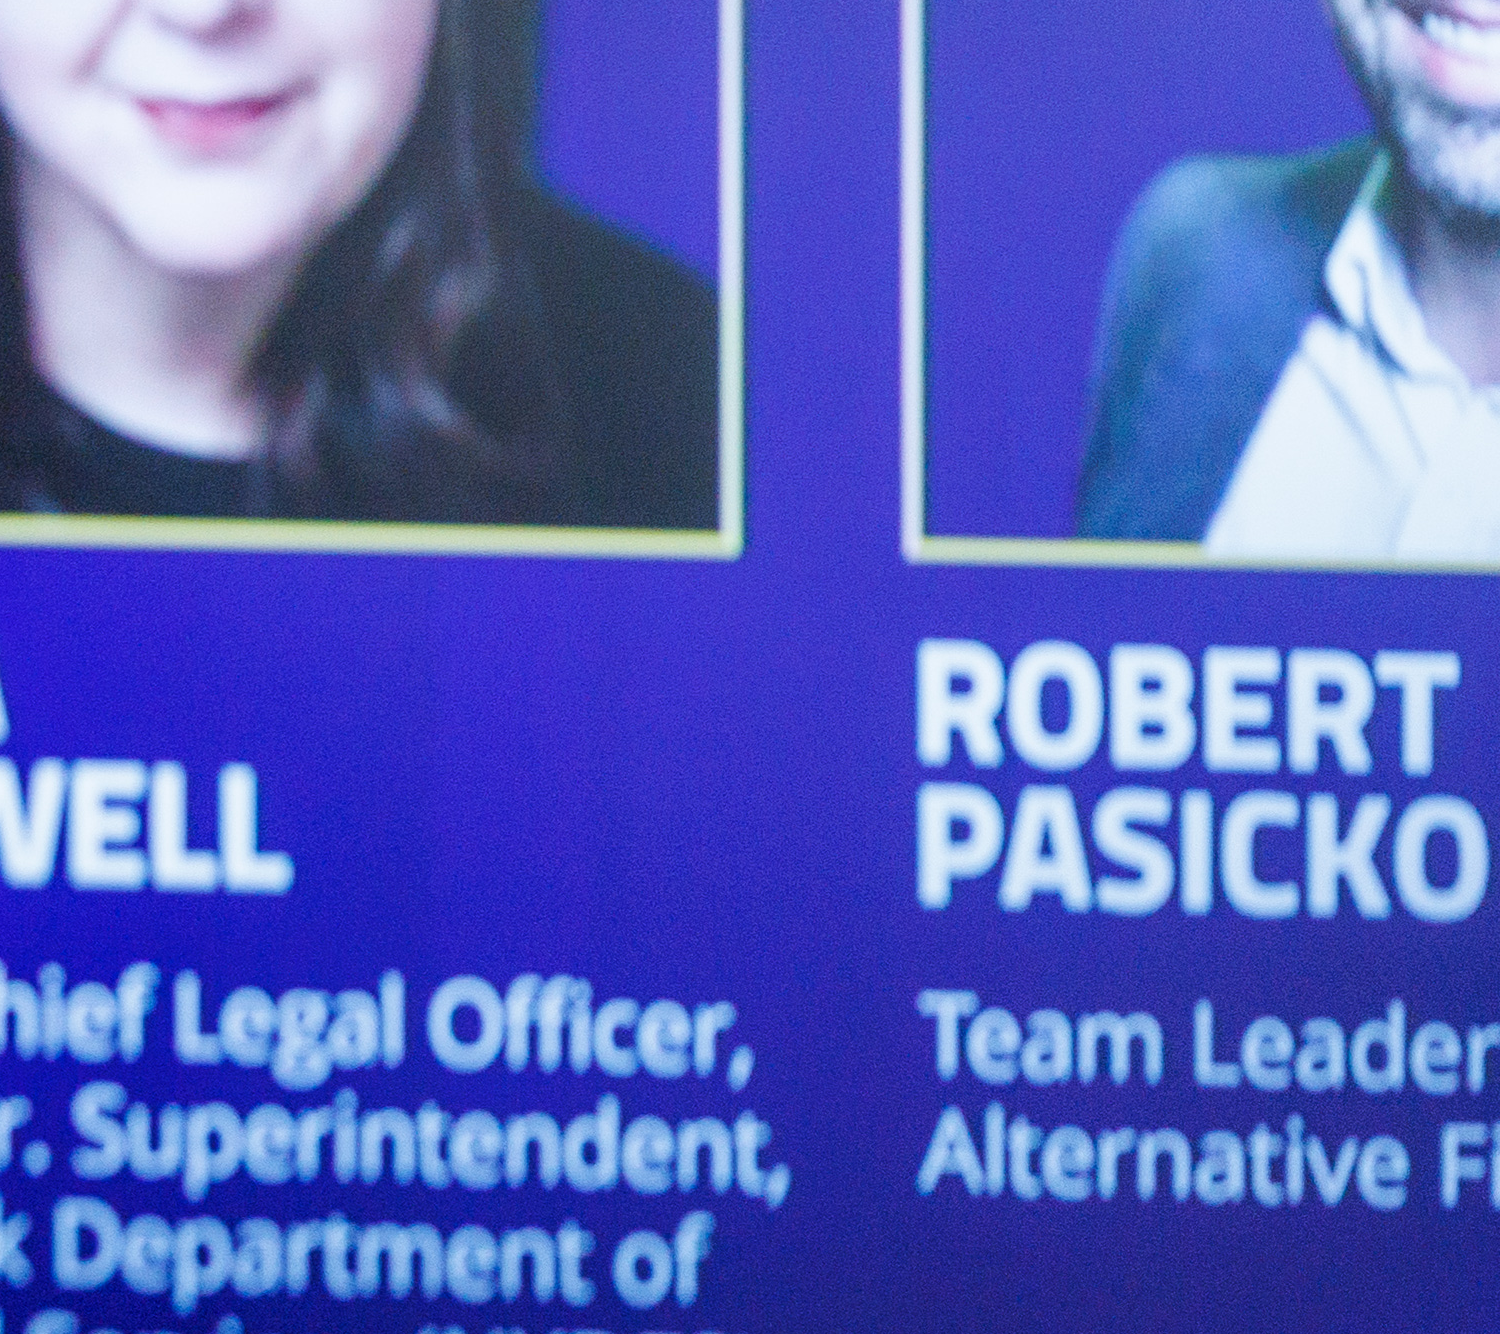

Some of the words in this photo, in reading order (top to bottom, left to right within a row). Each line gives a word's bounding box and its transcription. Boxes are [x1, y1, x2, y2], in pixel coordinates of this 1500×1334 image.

[917, 639, 1460, 775] ROBERT
[917, 783, 1489, 922] PASICKO
[174, 970, 405, 1089] Legal
[426, 974, 754, 1089] Officer,
[918, 990, 1164, 1085] Team
[1194, 999, 1500, 1094] Leader
[69, 1081, 790, 1207] Superintendent,
[918, 1103, 1410, 1209] Alternative
[52, 1195, 594, 1315] Department
[612, 1210, 714, 1308] of
